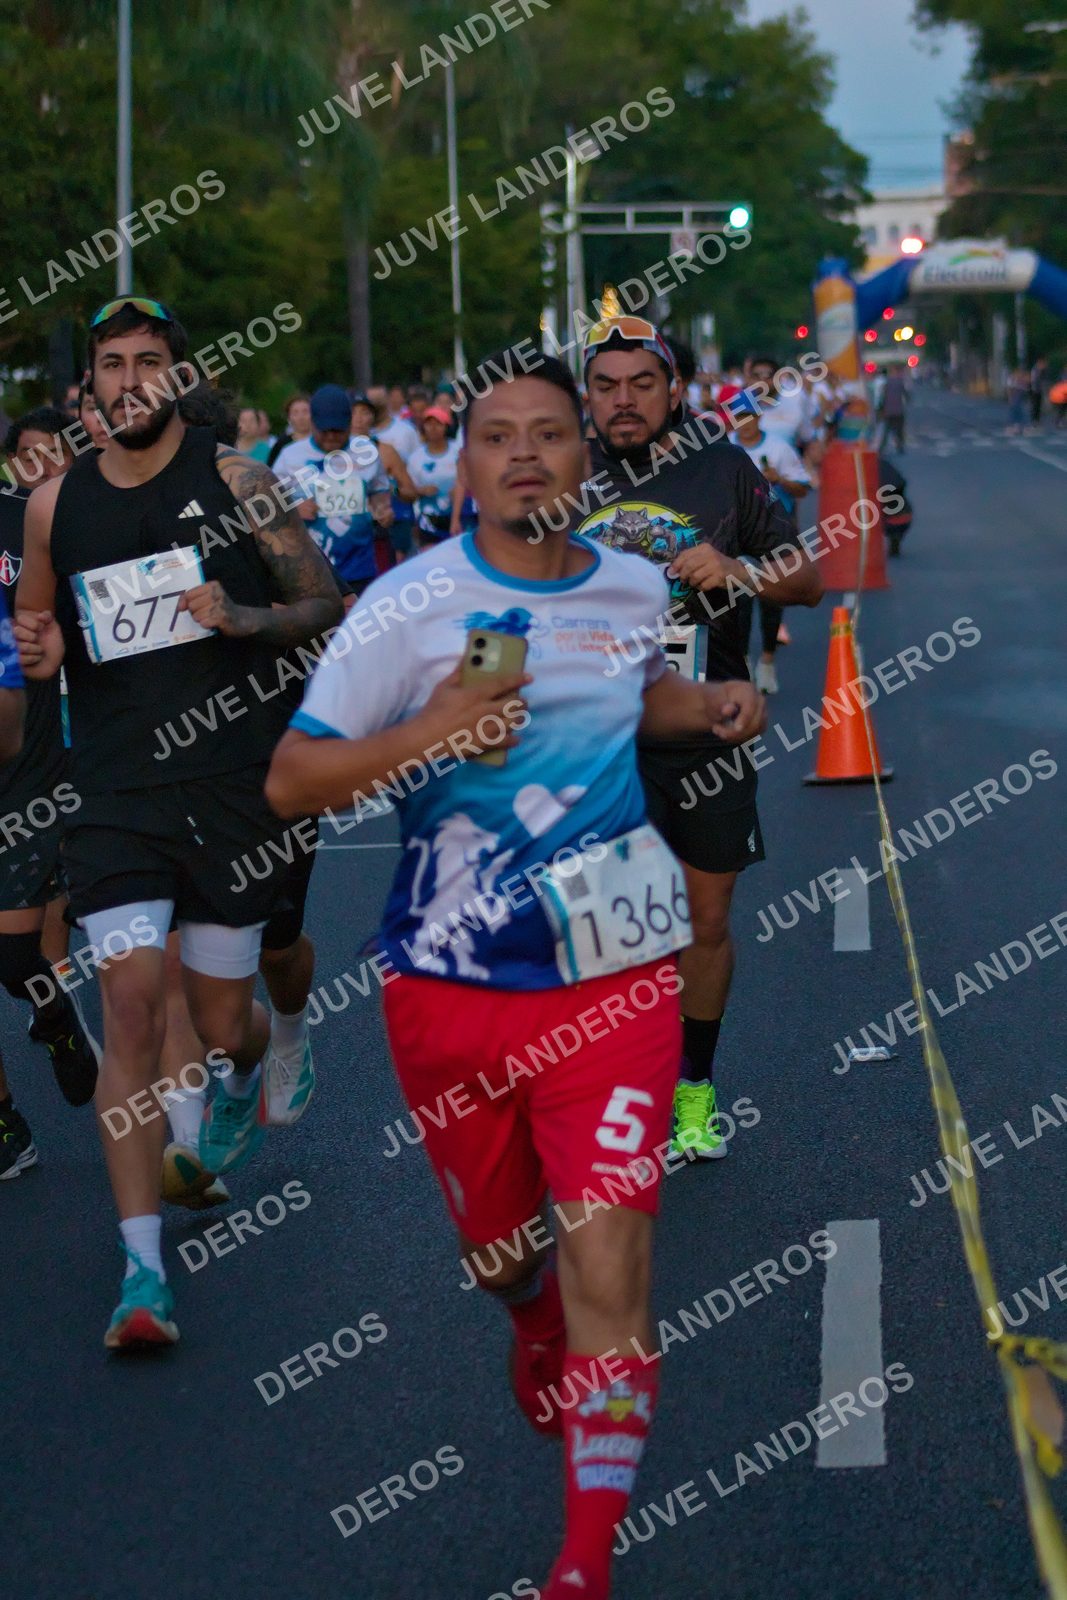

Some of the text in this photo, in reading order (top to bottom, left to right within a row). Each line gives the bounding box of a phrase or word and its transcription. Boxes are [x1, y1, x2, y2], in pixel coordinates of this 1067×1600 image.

[325, 493, 358, 512] 526
[112, 589, 186, 644] 677
[551, 616, 611, 630] Carrera
[581, 872, 691, 959] 1366
[594, 1085, 655, 1155] 5
